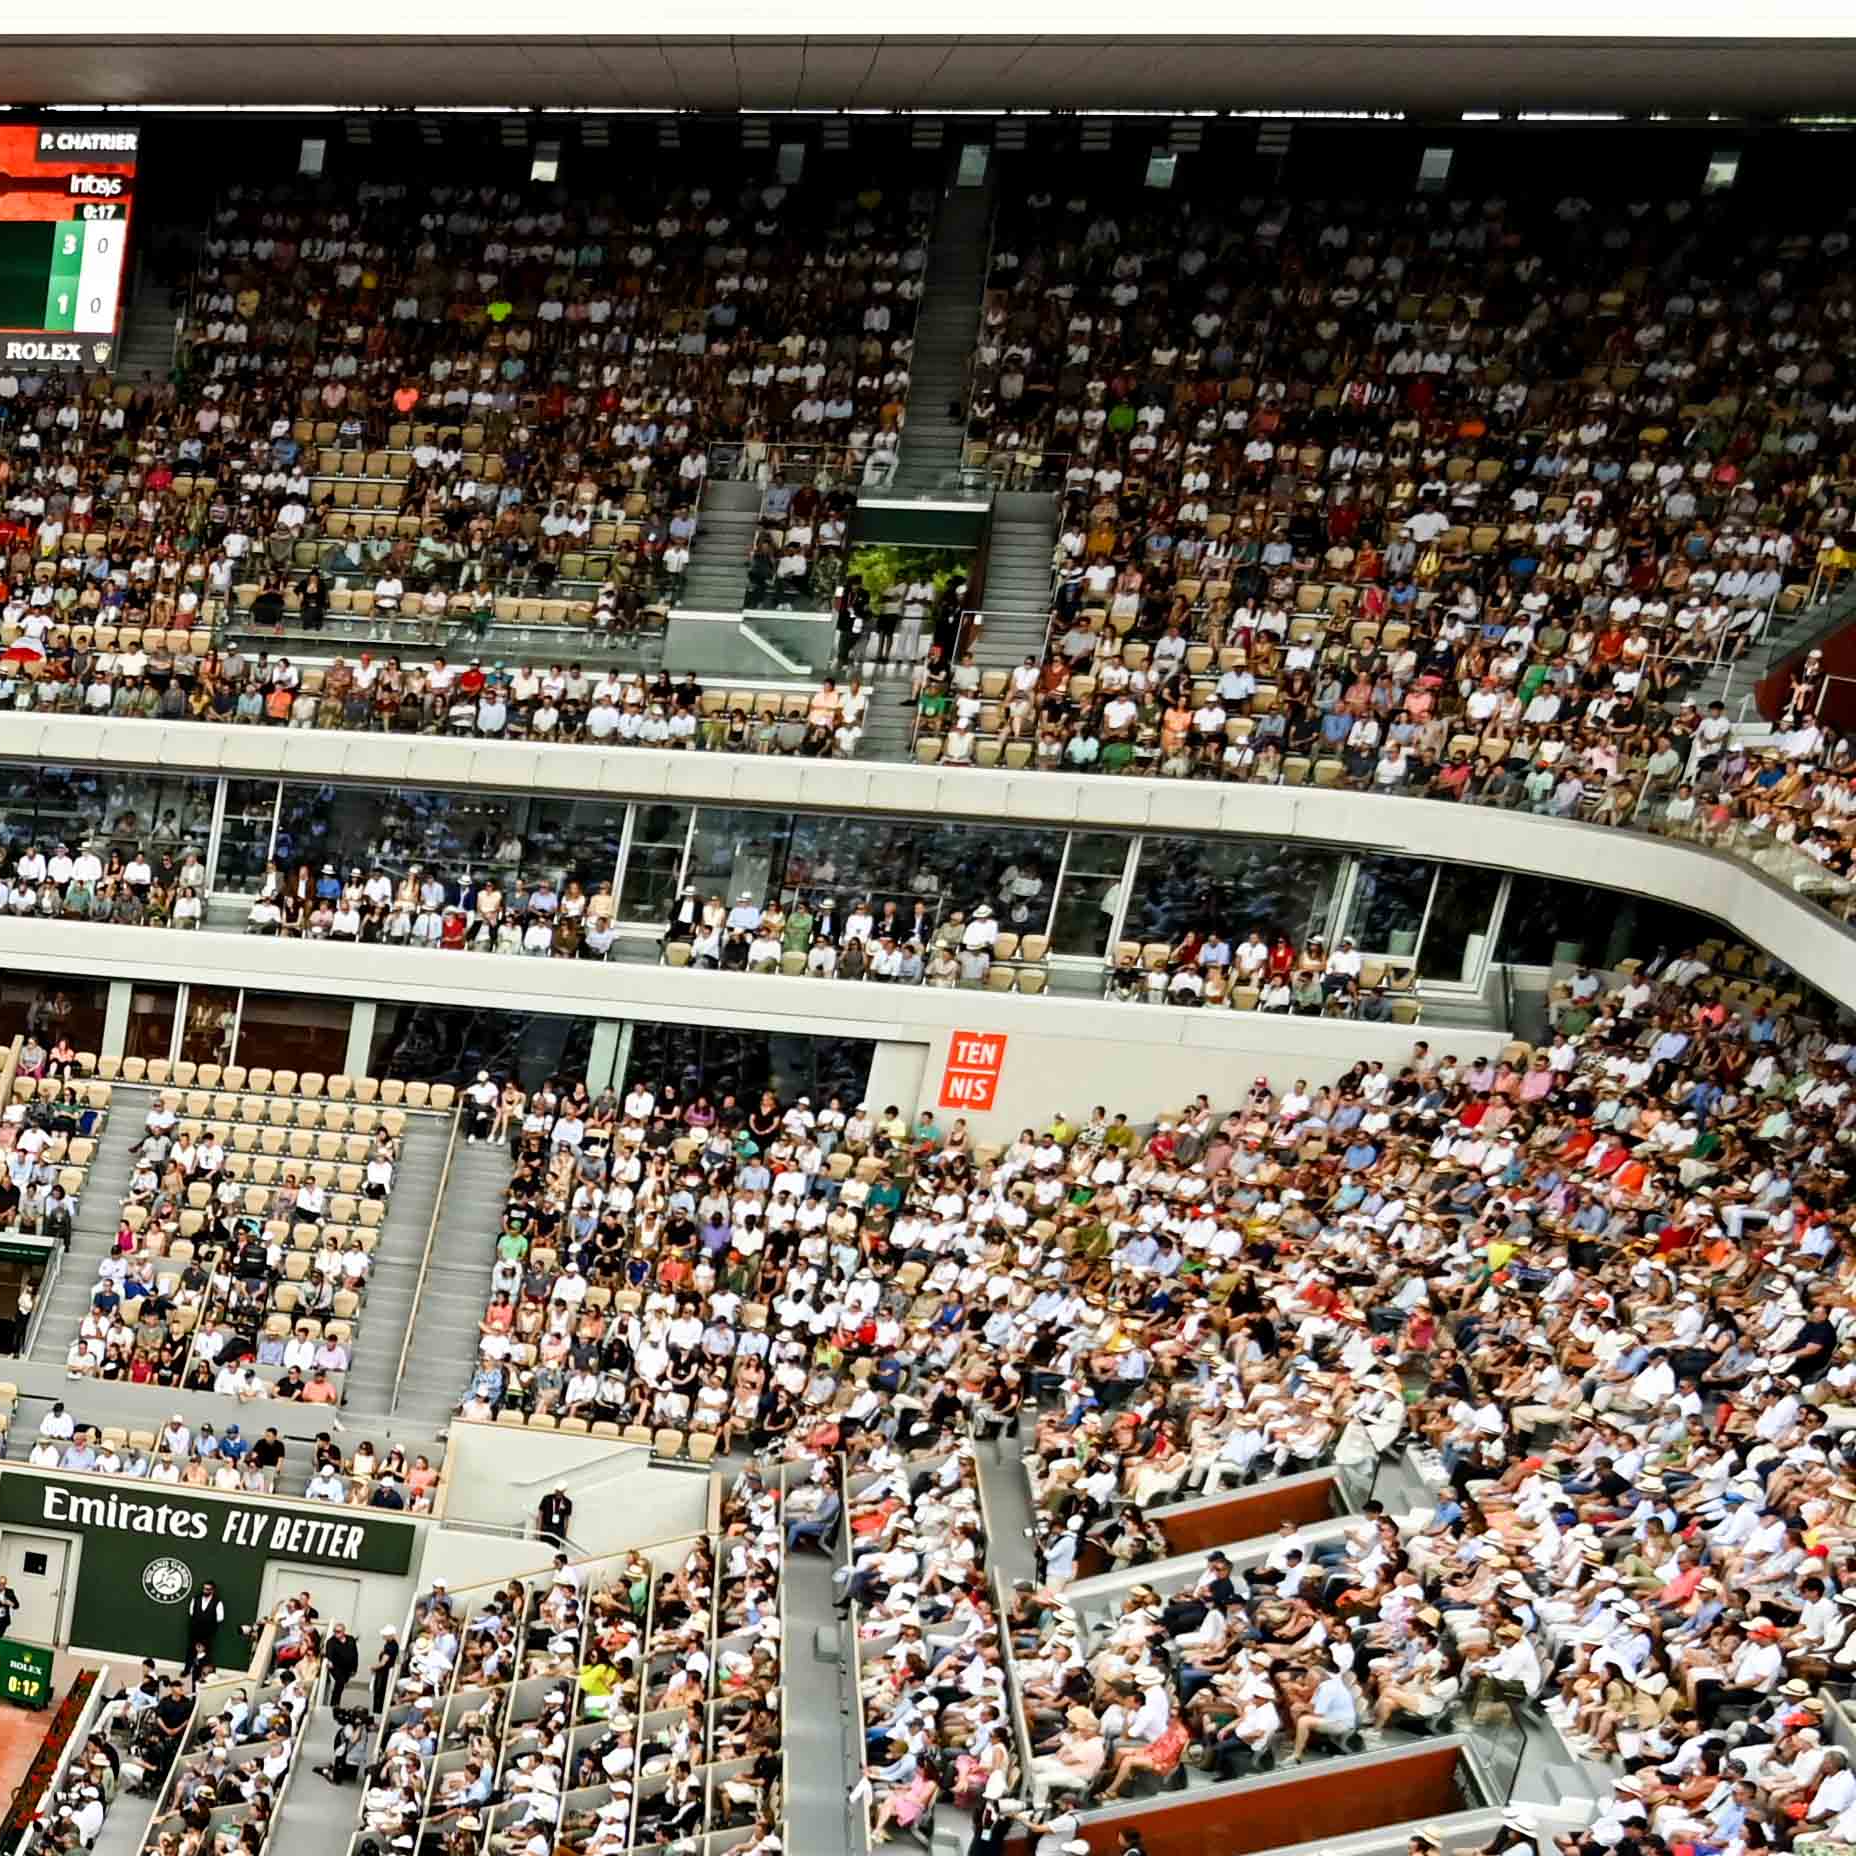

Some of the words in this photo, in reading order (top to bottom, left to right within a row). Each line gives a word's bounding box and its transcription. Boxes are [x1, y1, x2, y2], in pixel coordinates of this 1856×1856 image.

[40, 134, 54, 149] P.
[57, 133, 136, 151] CHATRIER
[70, 176, 122, 195] Infosys
[62, 235, 76, 254] 3
[97, 238, 108, 253] 0
[58, 295, 68, 314] 1
[91, 297, 101, 313] 0
[6, 342, 81, 360] ROLEX
[957, 1041, 997, 1064] TEN
[948, 1076, 988, 1101] NIS
[43, 1486, 208, 1539] Emirates
[221, 1510, 261, 1547] FLY
[269, 1516, 364, 1560] BETTER
[10, 1660, 42, 1675] ROLEX
